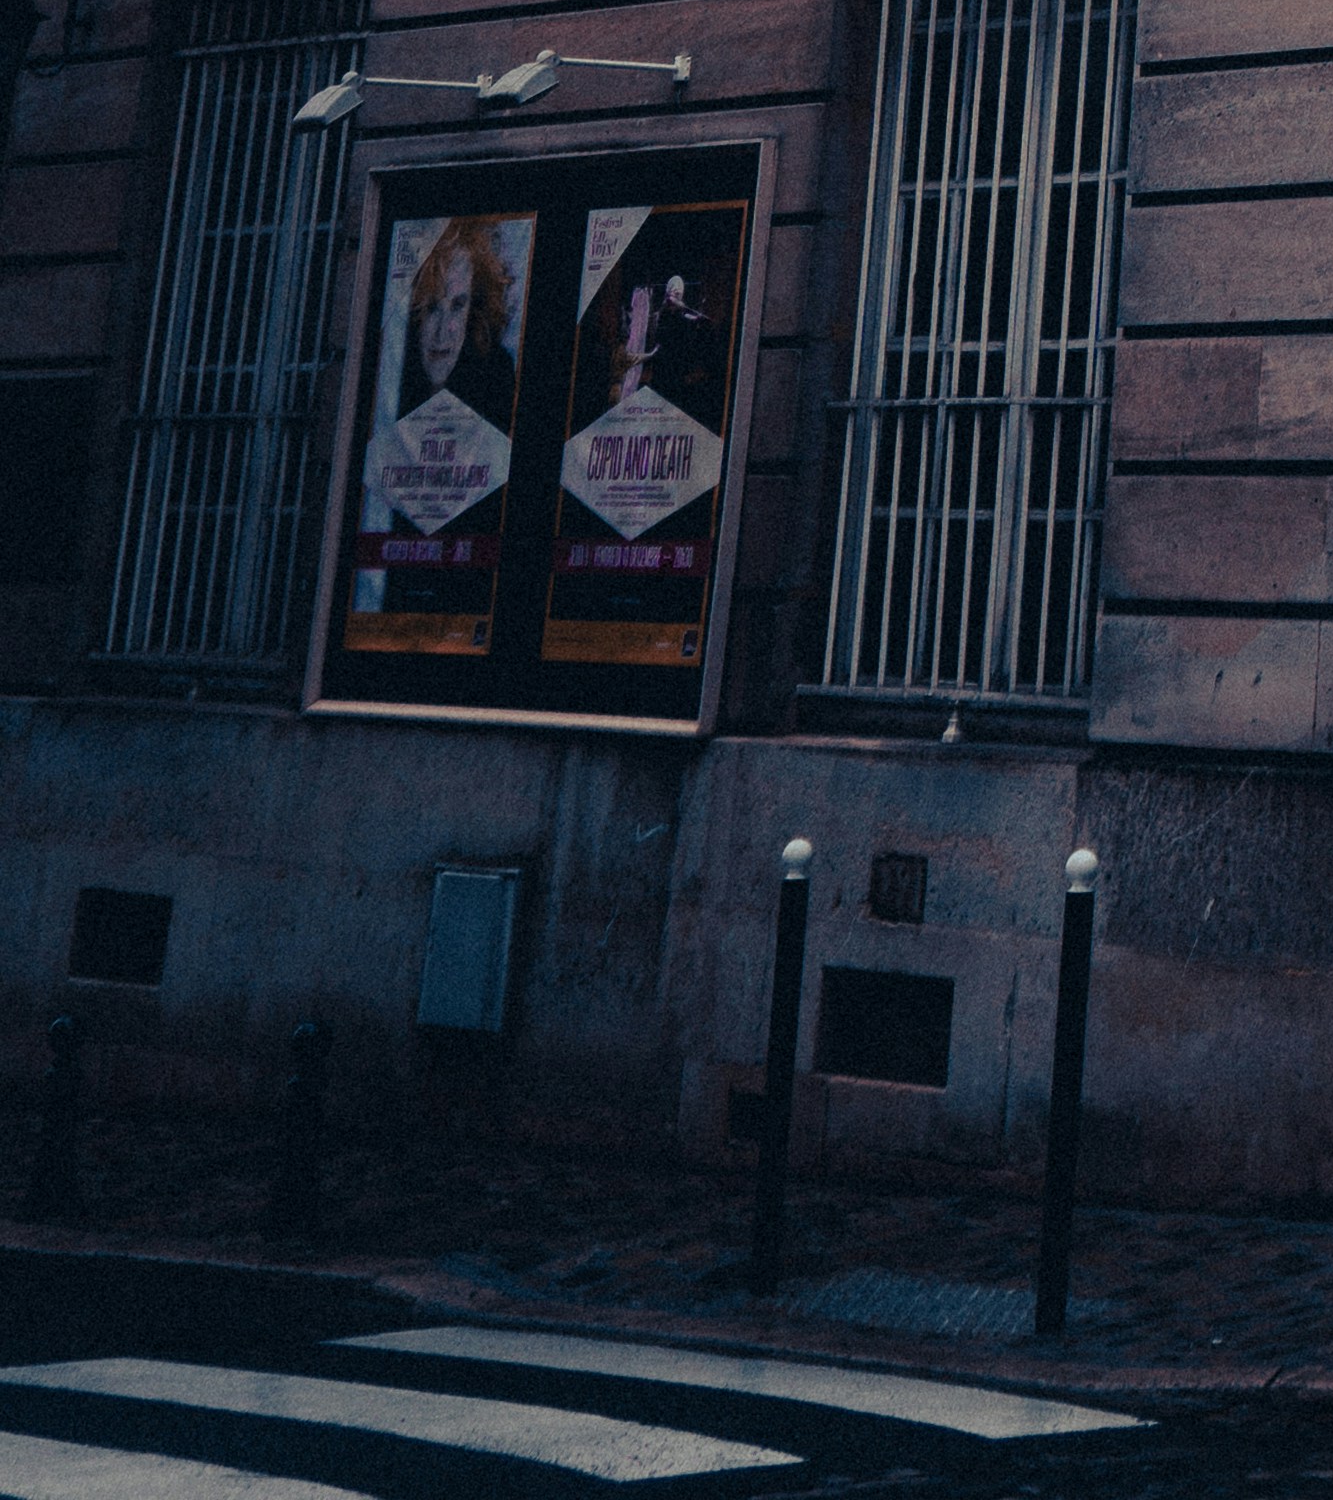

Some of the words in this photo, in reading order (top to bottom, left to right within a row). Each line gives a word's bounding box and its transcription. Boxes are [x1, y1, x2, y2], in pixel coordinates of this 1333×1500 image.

[587, 435, 623, 481] CUPID
[624, 435, 651, 481] AND
[651, 434, 694, 481] DEATH
